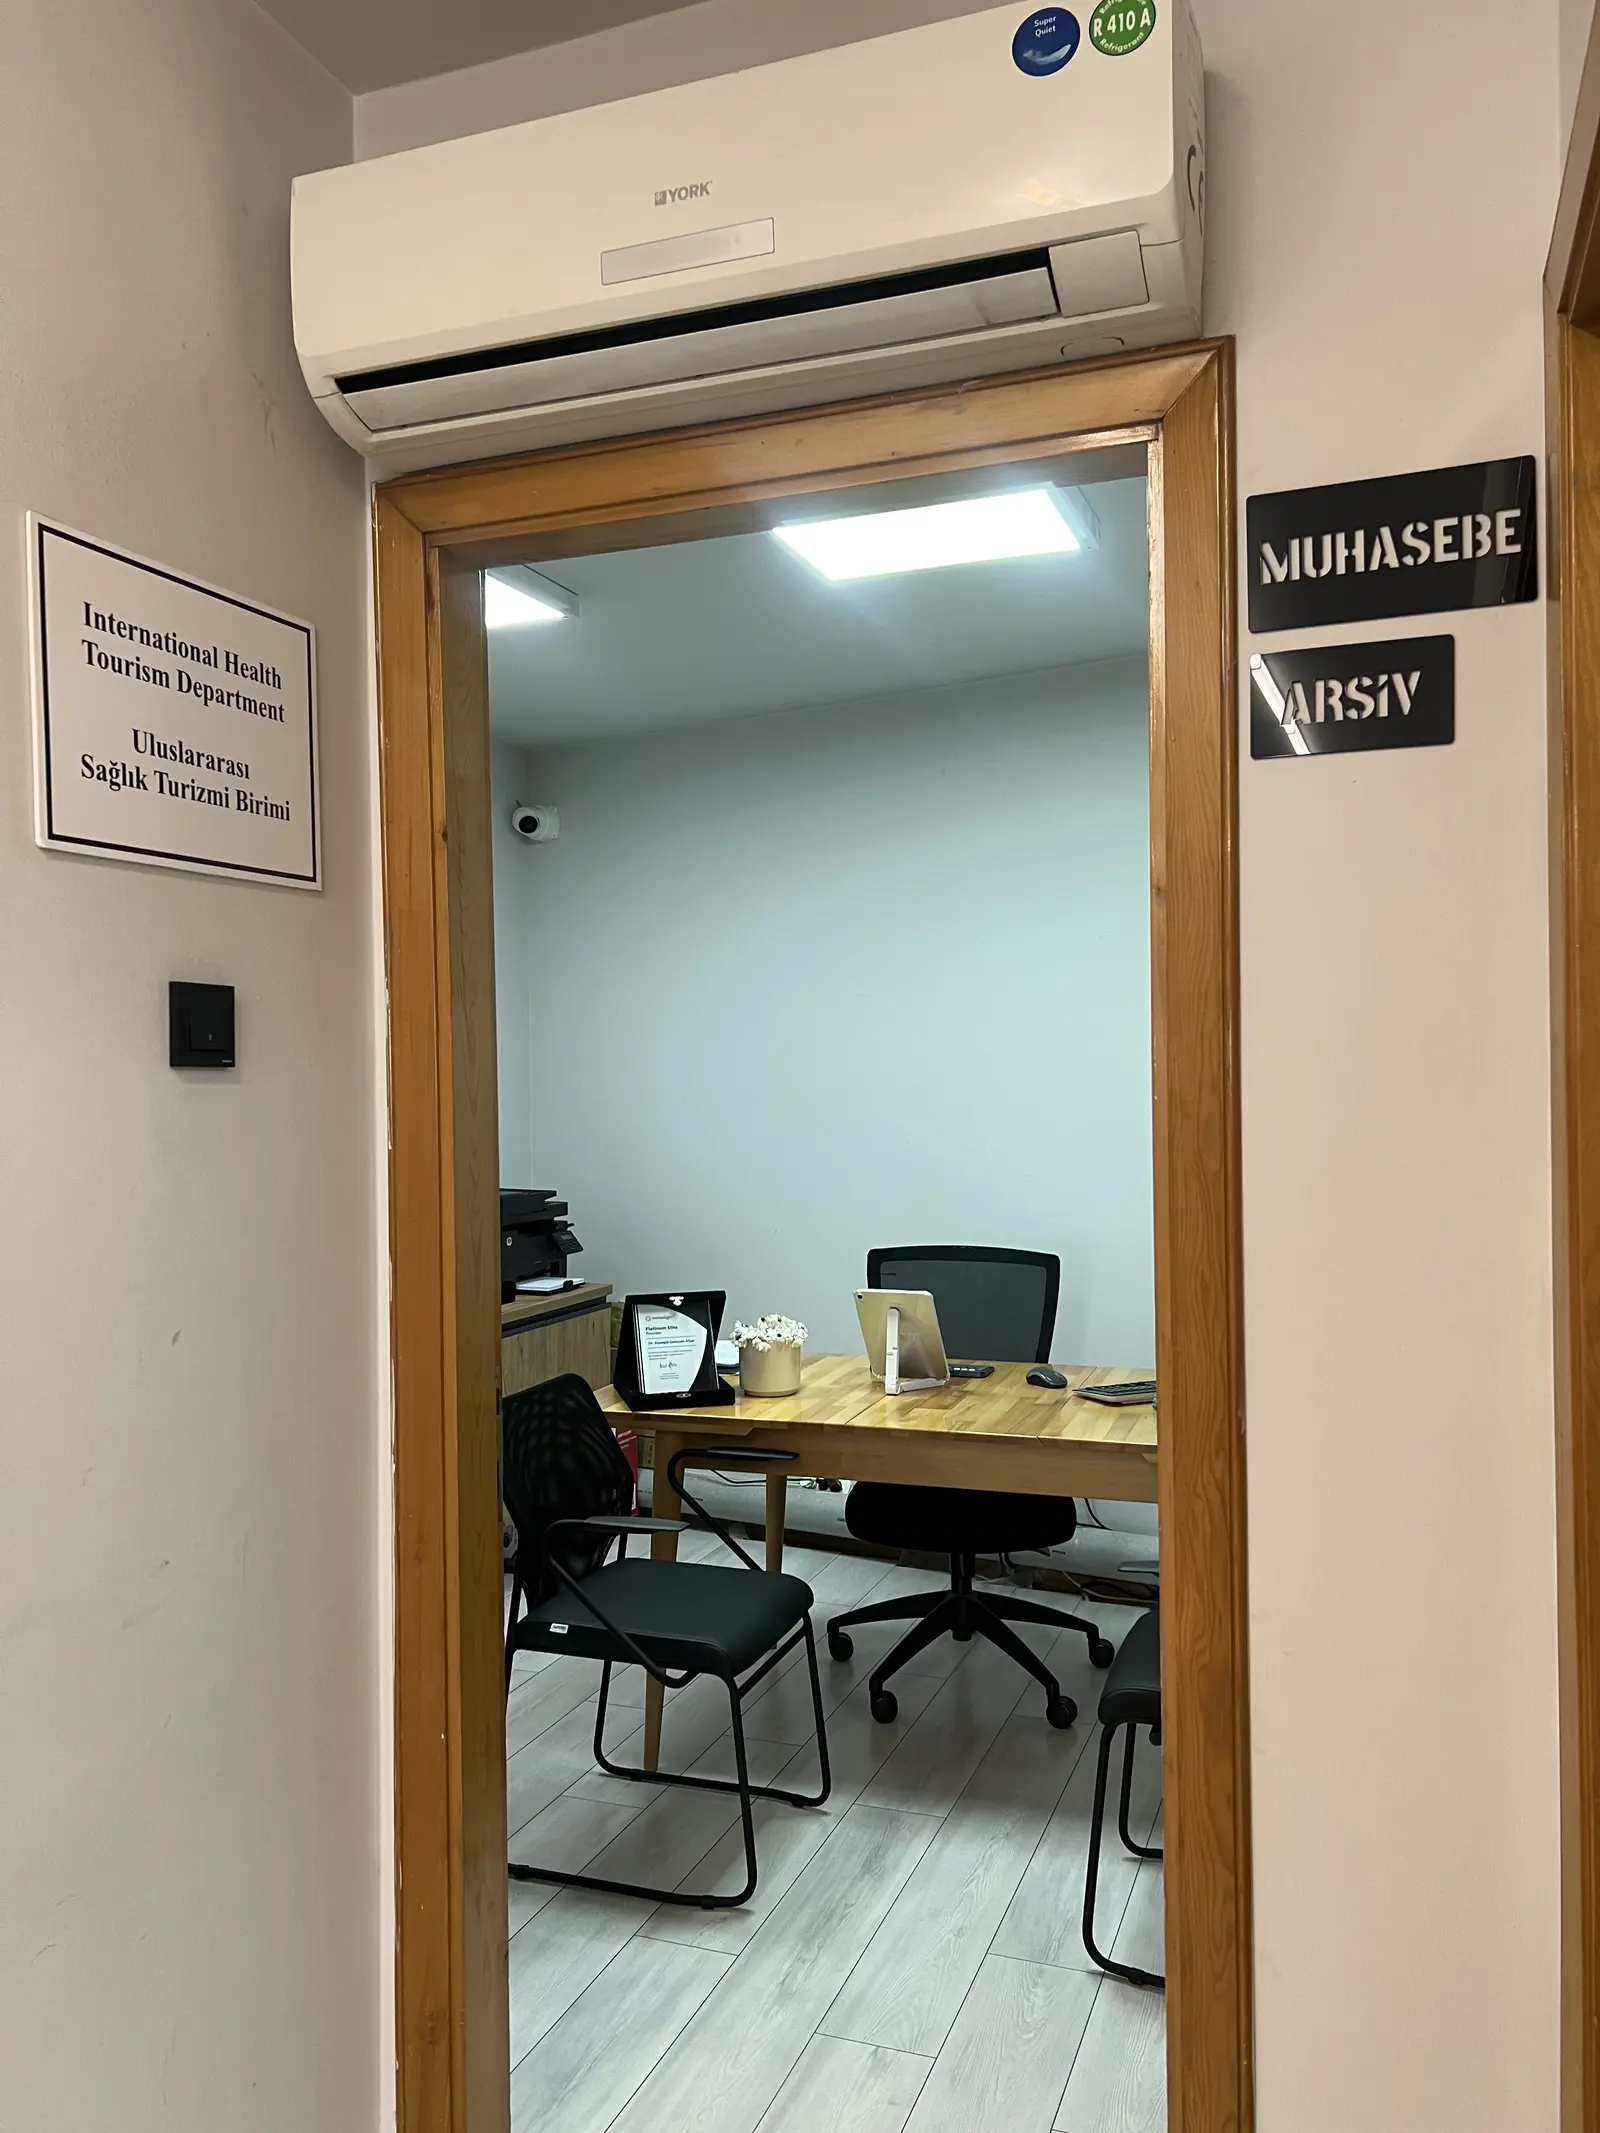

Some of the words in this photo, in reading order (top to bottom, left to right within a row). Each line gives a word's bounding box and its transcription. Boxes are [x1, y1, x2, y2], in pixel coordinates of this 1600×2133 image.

[1034, 15, 1057, 28] Super
[1034, 25, 1056, 38] Quiet
[1093, 17, 1103, 38] R
[1106, 10, 1136, 33] 410
[1139, 7, 1151, 28] A
[1099, 31, 1145, 53] Refrigerant
[667, 180, 711, 203] YORK
[1260, 508, 1522, 585] MUHASEBE
[82, 601, 219, 669] International
[224, 650, 282, 690] Health
[81, 639, 170, 689] Tourism
[176, 668, 286, 723] Department
[131, 728, 250, 780] Uluslararası
[81, 753, 149, 792] Sağlık
[153, 769, 230, 809] Turizmi
[235, 788, 291, 822] Birimi
